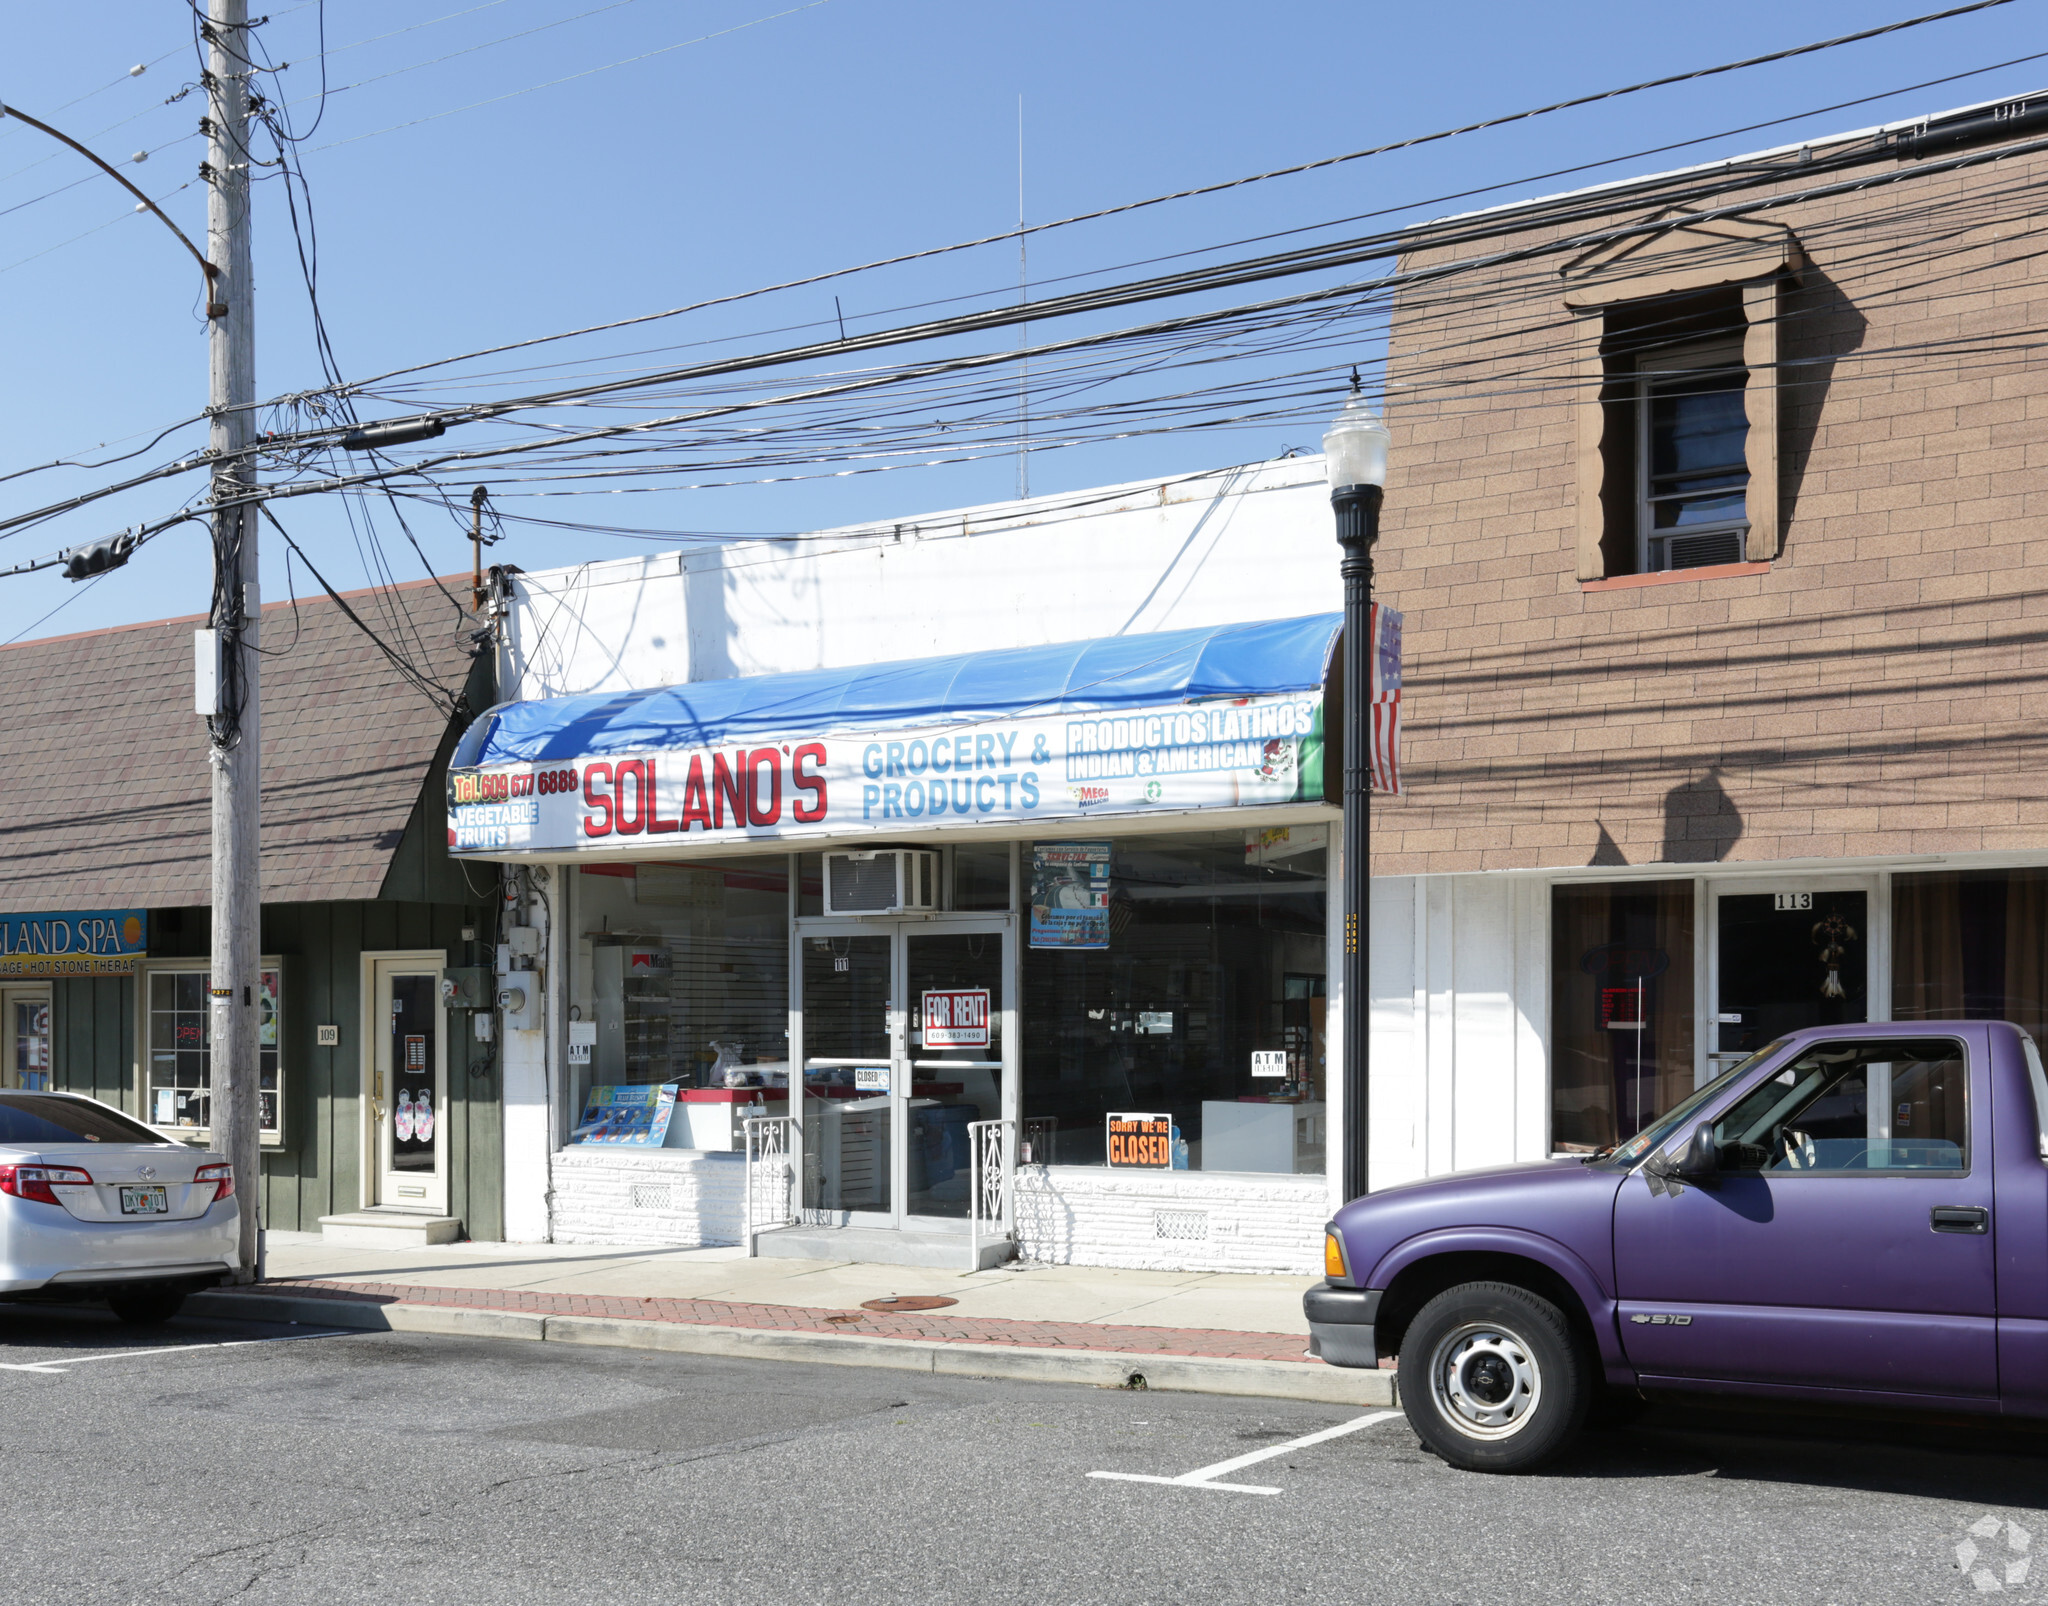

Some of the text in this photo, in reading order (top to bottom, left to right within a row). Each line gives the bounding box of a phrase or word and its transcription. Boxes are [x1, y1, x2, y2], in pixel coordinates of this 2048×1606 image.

[1068, 701, 1314, 754] PRODUCTOS LATINOS
[863, 731, 1051, 779] GROCERY &
[1068, 740, 1263, 780] INDIAN & AMERICAN
[455, 769, 578, 802] Tel. 609 677 6888
[583, 742, 828, 839] SOLANO'S
[1080, 786, 1109, 801] MEGA
[863, 771, 1040, 820] PRODUCTS
[456, 803, 539, 827] VEGETABLE
[456, 826, 508, 847] FRUITS
[1777, 893, 1811, 909] 113
[0, 918, 122, 956] LAND SPA
[30, 961, 51, 973] HOT
[54, 960, 90, 973] STONE
[834, 958, 848, 971] 111
[926, 995, 986, 1027] FOR RENT
[176, 1026, 204, 1040] OPEN
[320, 1029, 336, 1041] 109
[569, 1045, 589, 1055] ATM
[1254, 1053, 1284, 1065] ATM
[857, 1071, 878, 1082] CLOSED
[1110, 1120, 1168, 1133] SORRY WE'RE
[1109, 1134, 1169, 1165] CLOSED
[124, 1194, 140, 1208] DKY
[1650, 1313, 1692, 1326] S10
